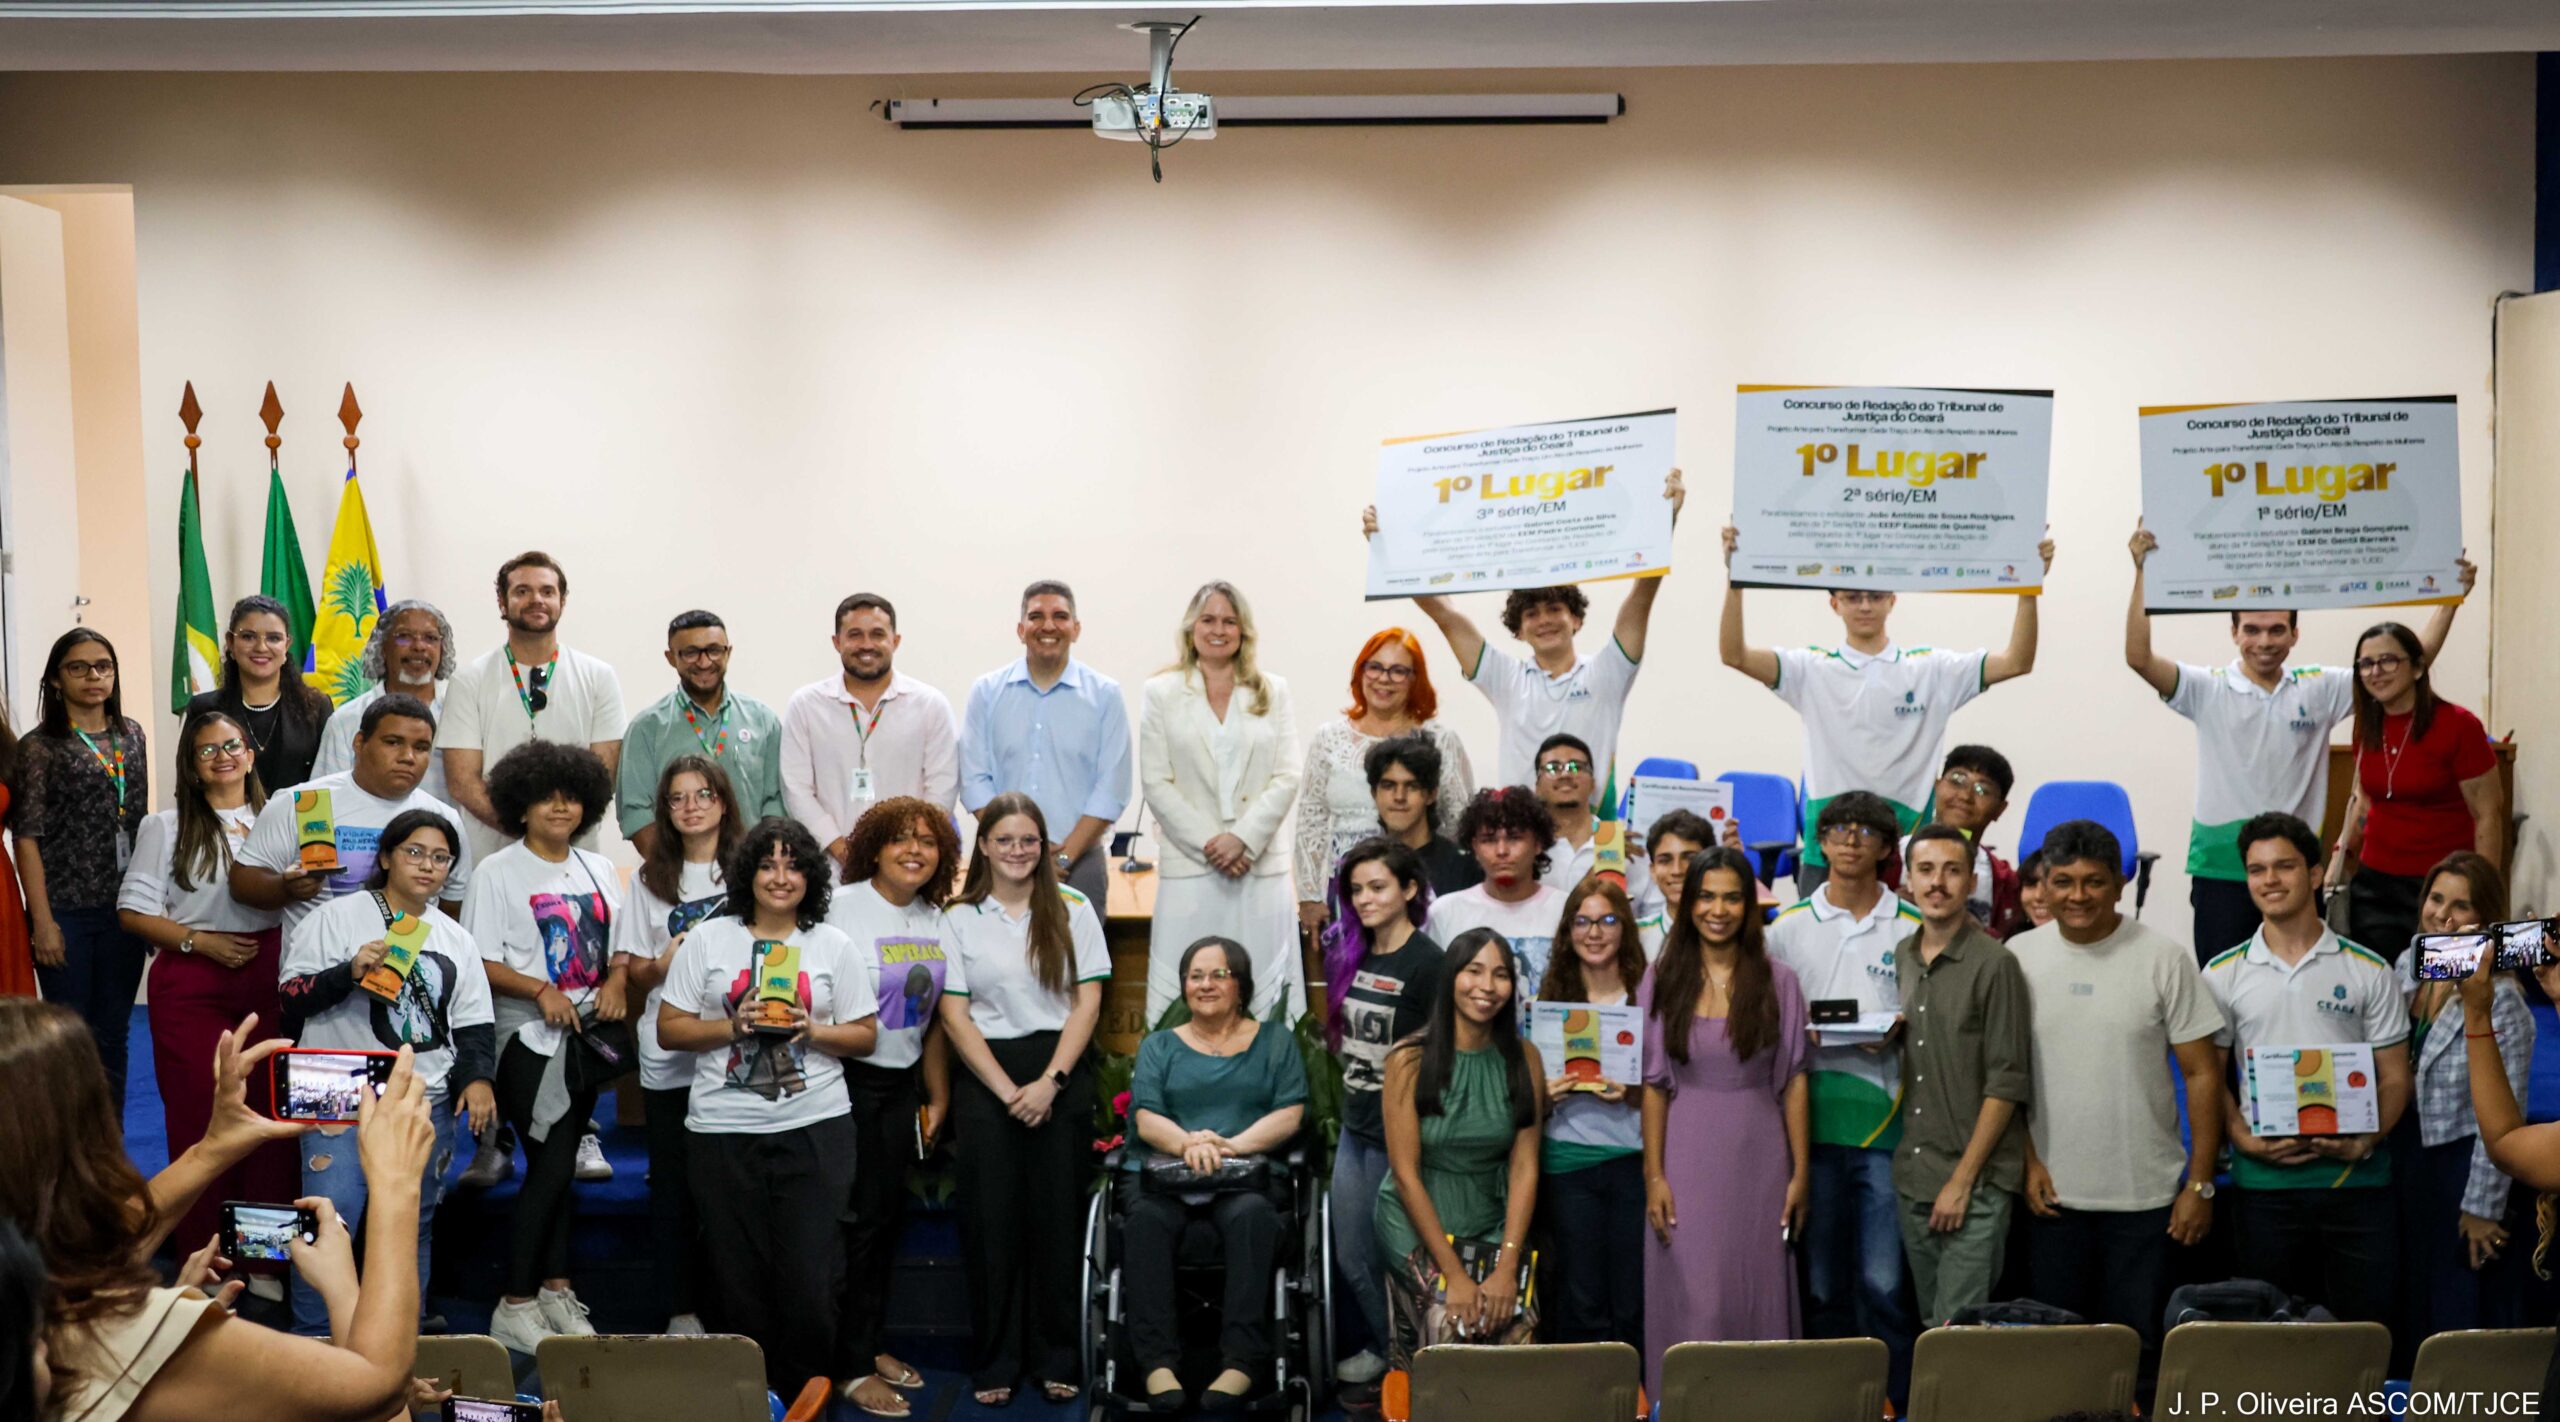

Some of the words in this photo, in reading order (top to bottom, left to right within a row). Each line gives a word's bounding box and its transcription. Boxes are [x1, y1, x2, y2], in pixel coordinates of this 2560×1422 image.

[1783, 399, 1842, 411] Concurso
[1845, 400, 1860, 410] de
[1863, 400, 1916, 414] Redação
[1918, 401, 1934, 411] do
[1936, 401, 1985, 412] Tribunal
[1988, 402, 2004, 413] de
[1842, 412, 1888, 425] Justiça
[1890, 412, 1906, 422] do
[1908, 412, 1944, 423] Ceará
[2187, 419, 2246, 431] Concurso
[2249, 418, 2264, 428] de
[2267, 416, 2321, 430] Redação
[2323, 414, 2339, 424] do
[2342, 412, 2390, 423] Tribunal
[2393, 411, 2409, 422] de
[1423, 441, 1479, 455] Concurso
[1480, 439, 1495, 449] de
[1497, 434, 1547, 450] Redação
[1567, 426, 1613, 440] Tribunal
[1615, 424, 1630, 435] de
[2247, 428, 2294, 441] Justiça
[2296, 426, 2312, 437] do
[2314, 425, 2351, 436] Ceará
[1478, 444, 1521, 458] Justiça
[1522, 443, 1538, 454] do
[1540, 440, 1574, 451] Ceará
[1796, 443, 1838, 477] 1º
[1846, 444, 1987, 487] Lugar
[1433, 476, 1472, 504] 1º
[1480, 464, 1615, 500] Lugar
[2203, 462, 2246, 497] 1º
[2255, 461, 2397, 502] Lugar
[1843, 489, 1861, 502] 2ª
[1865, 489, 1937, 505] série/EM
[1477, 508, 1495, 521] 3ª
[1498, 500, 1567, 518] série/EM
[2257, 506, 2271, 520] 1ª
[2274, 503, 2347, 521] série/EM
